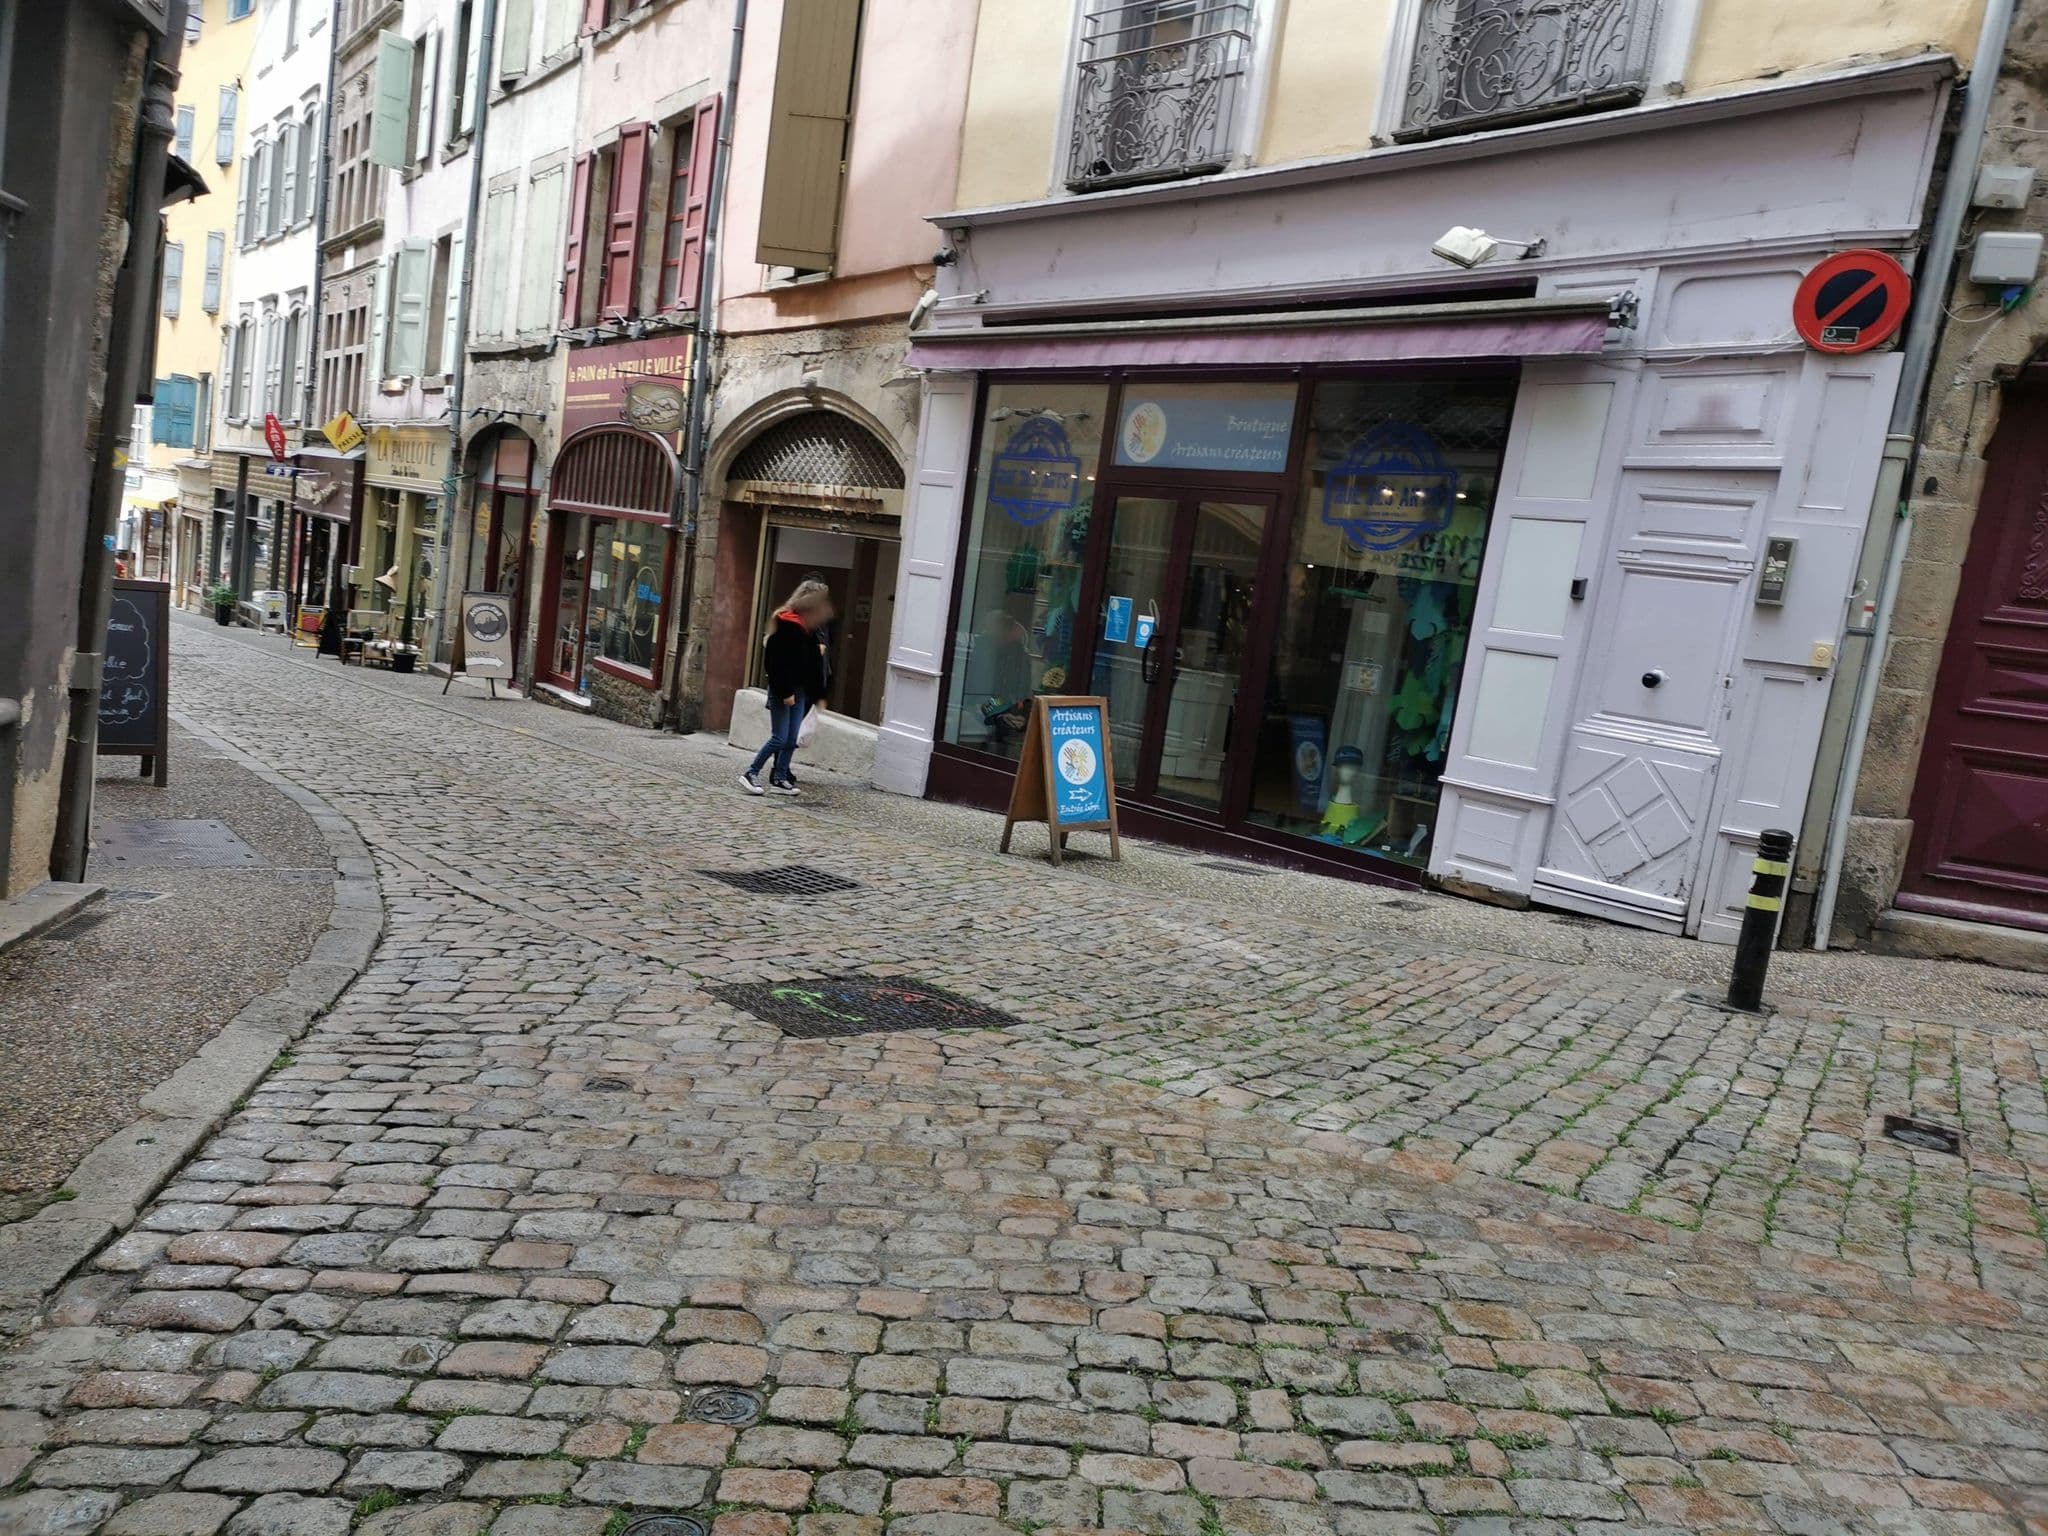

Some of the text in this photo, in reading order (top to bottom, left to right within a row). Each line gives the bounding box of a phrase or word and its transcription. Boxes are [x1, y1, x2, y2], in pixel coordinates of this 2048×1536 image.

[577, 364, 597, 382] PAIN
[597, 363, 608, 380] de
[618, 358, 653, 378] VIEILLE
[654, 355, 683, 376] VILLE
[1228, 415, 1288, 439] Boutique
[268, 419, 282, 457] TABAC
[338, 431, 360, 449] PRESSE
[377, 440, 437, 466] LA PAILLOTE
[1171, 442, 1282, 461] Artisans créateurs
[769, 482, 817, 506] PETIT
[820, 485, 880, 513] ENCAS
[1052, 709, 1093, 722] Artisans
[1052, 722, 1095, 736] créateurs
[1060, 802, 1083, 815] Entrée
